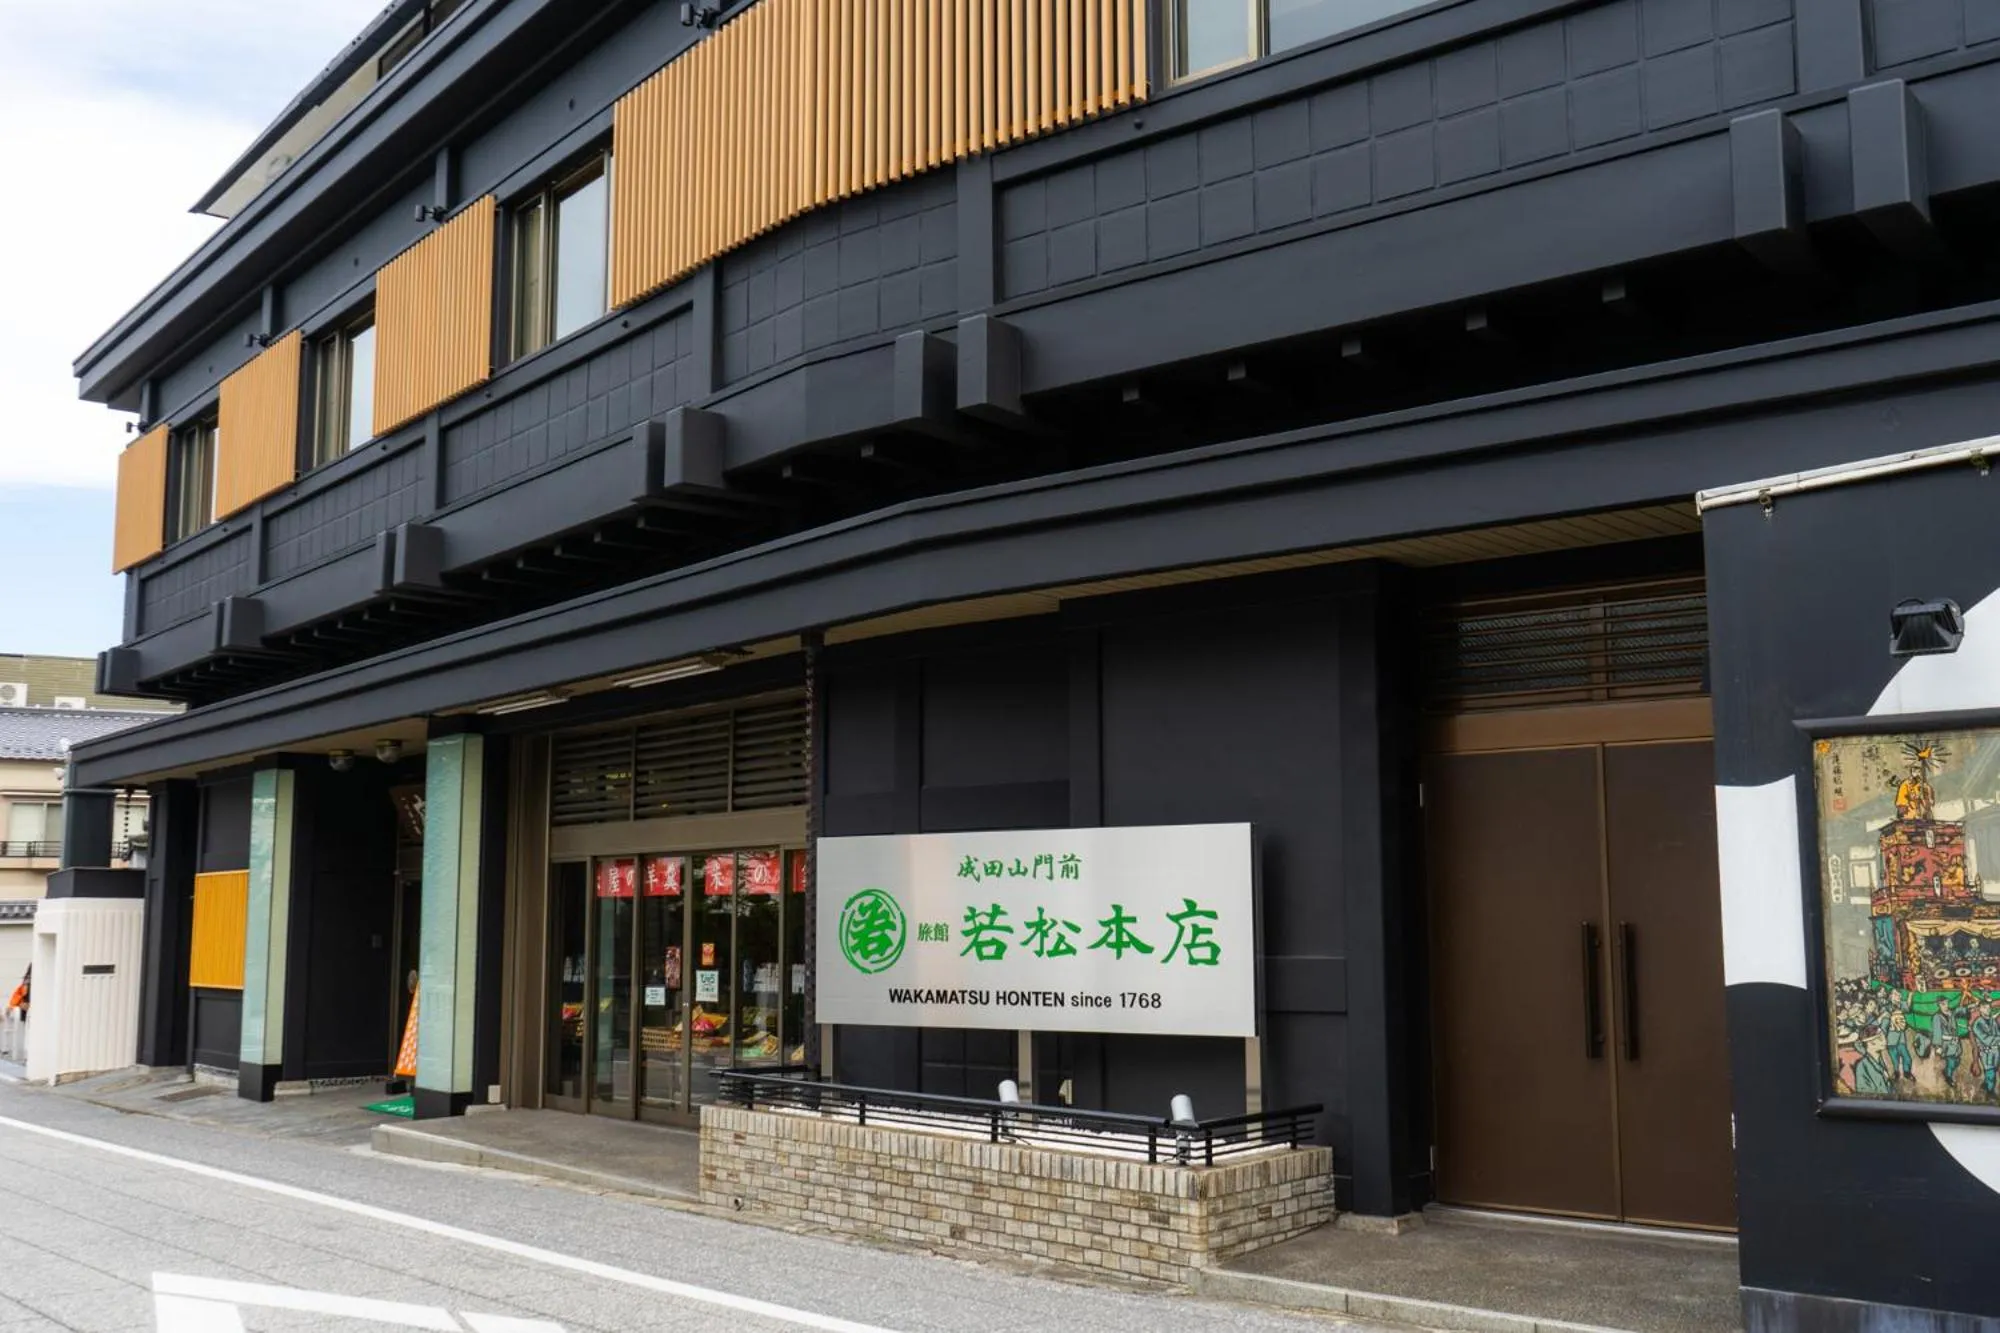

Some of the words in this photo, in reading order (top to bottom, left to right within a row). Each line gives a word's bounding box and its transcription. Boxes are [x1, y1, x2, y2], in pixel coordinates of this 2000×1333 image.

[956, 854, 1081, 881] 成田山門前
[918, 923, 949, 943] 旅館
[960, 898, 1222, 967] 若松本店
[889, 988, 990, 1006] WAKAMATSU
[996, 990, 1065, 1007] HONTEN
[1071, 993, 1112, 1008] since
[1119, 992, 1162, 1009] 1768
